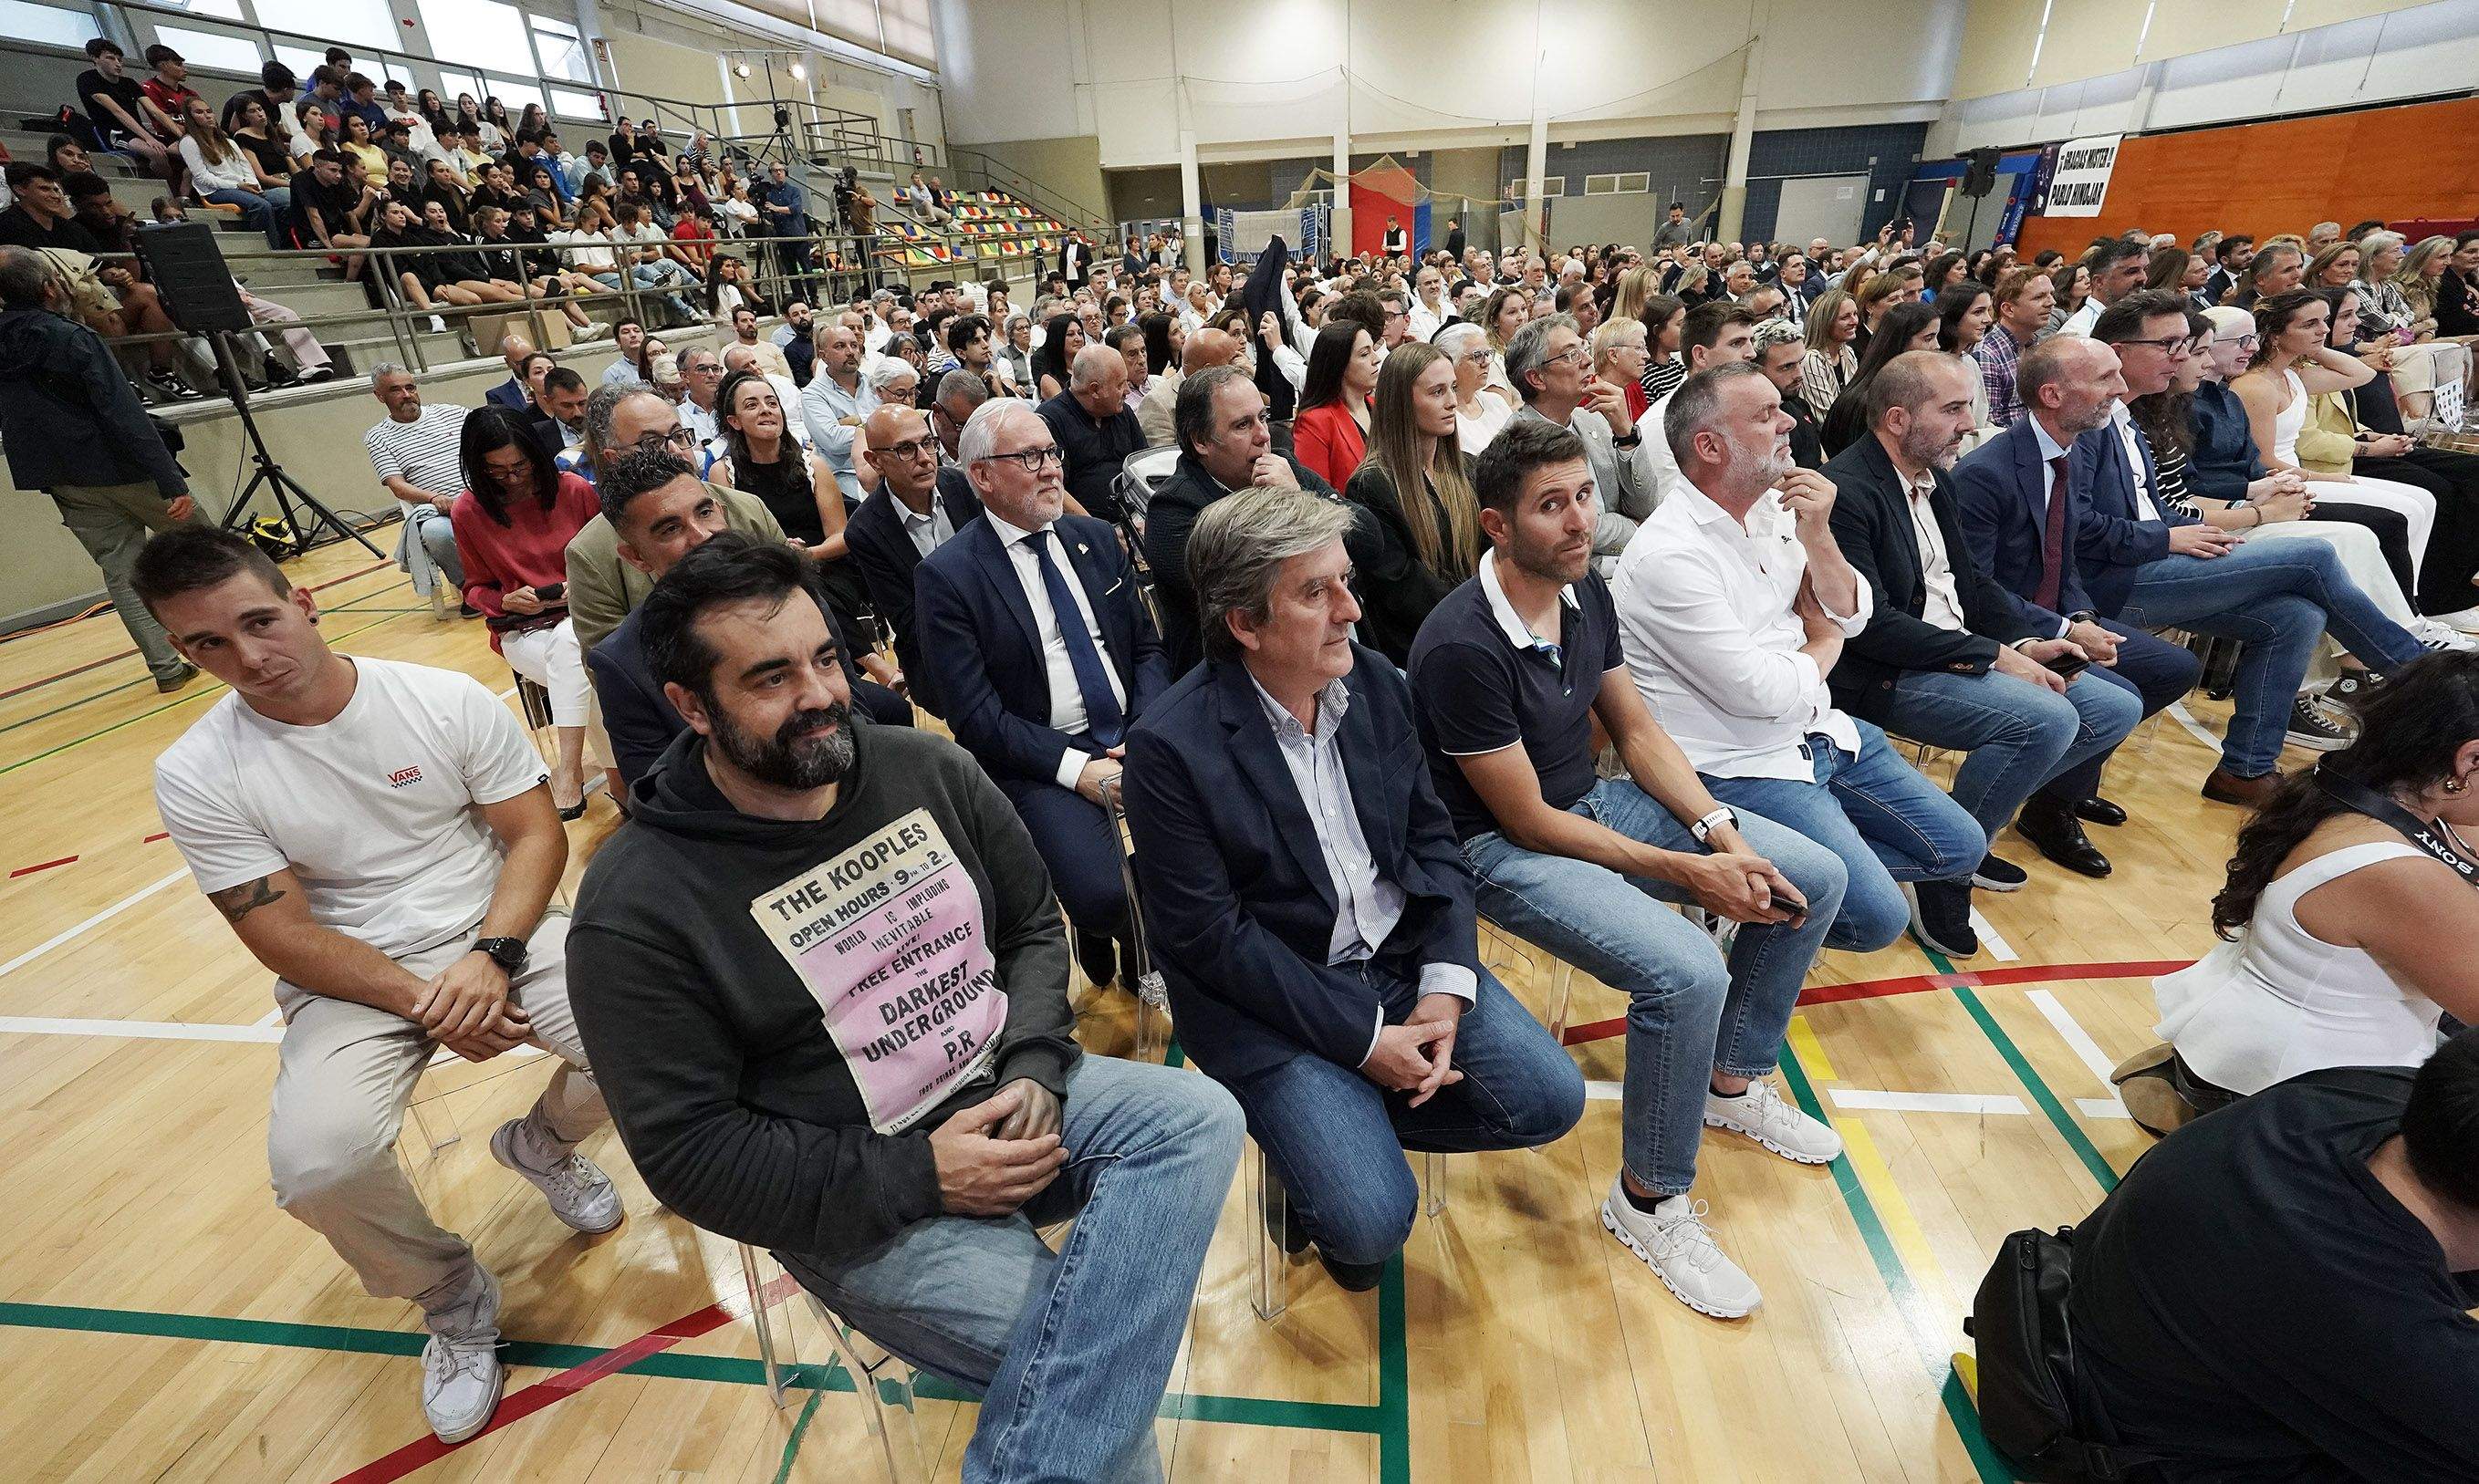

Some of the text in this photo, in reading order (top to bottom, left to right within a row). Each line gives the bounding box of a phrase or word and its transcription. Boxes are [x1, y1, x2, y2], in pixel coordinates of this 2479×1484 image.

[2063, 150, 2088, 171] GRACIAS
[2085, 147, 2109, 169] MISTER
[2049, 182, 2104, 206] PABLO HINOJAR
[387, 765, 421, 783] VANS
[769, 822, 929, 921] THE KOOPLES
[2413, 830, 2474, 875] SONY
[789, 913, 837, 948] OPEN
[834, 881, 891, 922] HOURS
[893, 868, 910, 886] 9
[919, 862, 930, 873] TO
[926, 850, 943, 867] 2
[834, 877, 951, 955] WORLD IS IMPLODING
[870, 907, 933, 953] INEVITABLE
[895, 933, 921, 955] LIVE!
[849, 920, 973, 998] FREE ENTRANCE
[914, 968, 929, 979] THE
[878, 959, 968, 1026] DARKEST
[861, 968, 995, 1063] UNDERGROUND
[940, 1025, 955, 1038] AND
[943, 1030, 976, 1064] P.R
[949, 1071, 971, 1094] OUTDOOR
